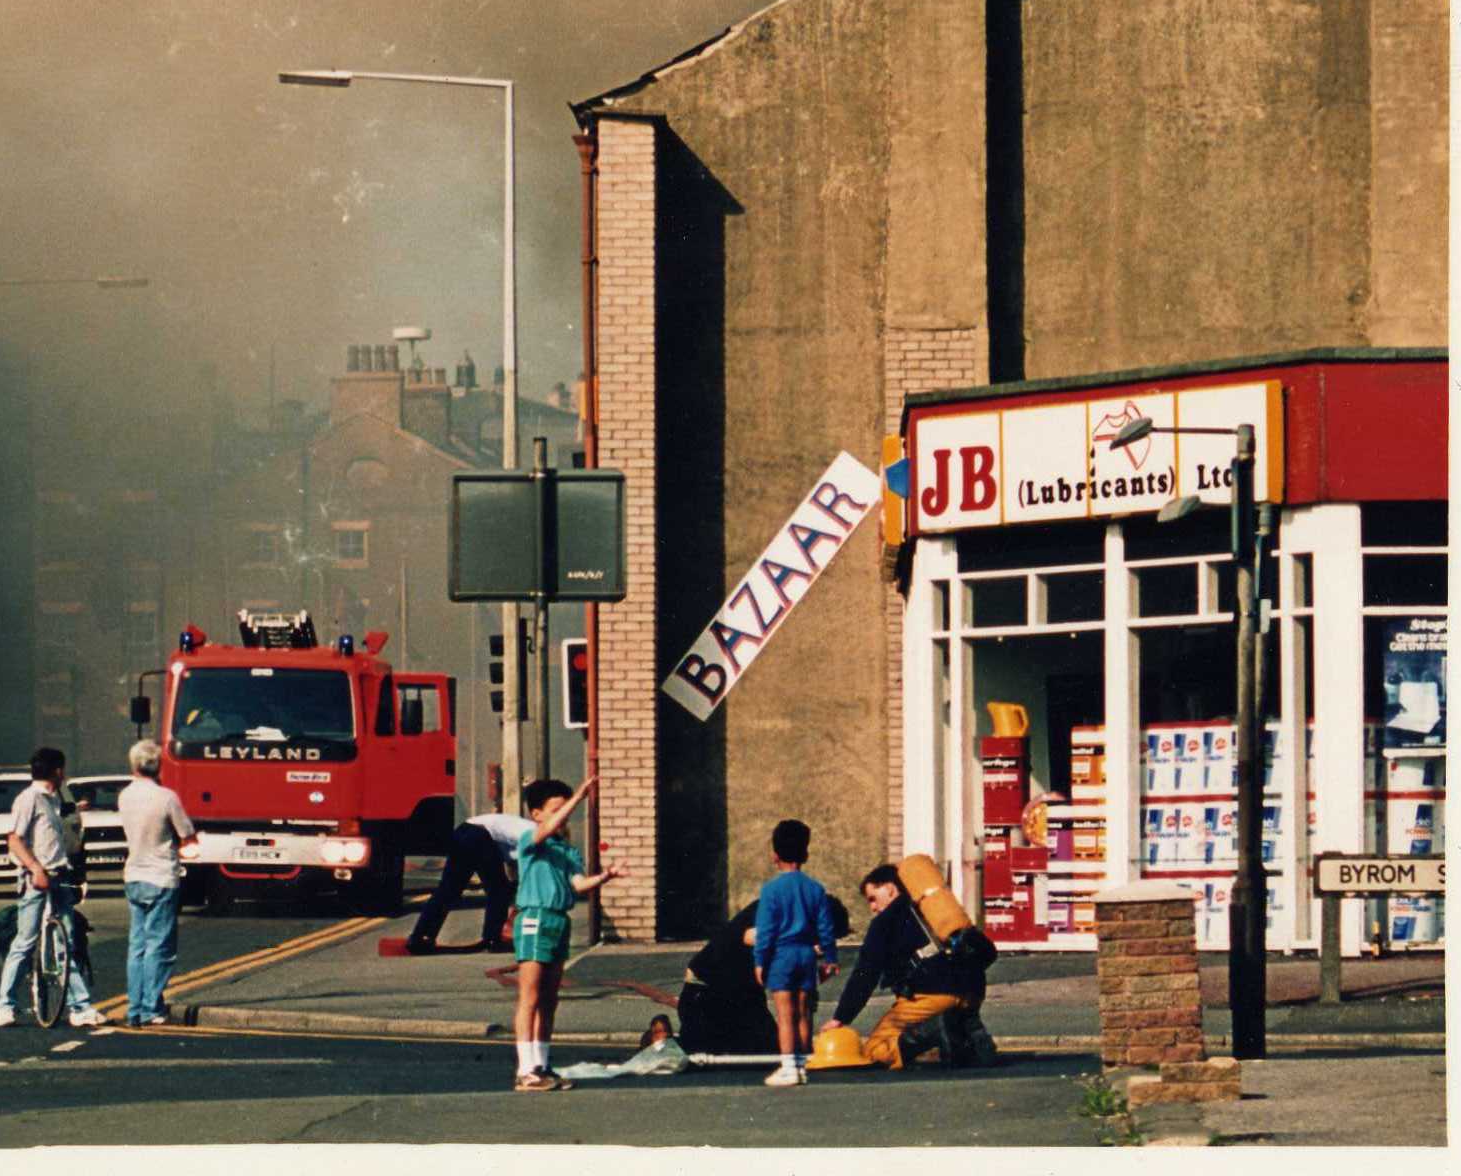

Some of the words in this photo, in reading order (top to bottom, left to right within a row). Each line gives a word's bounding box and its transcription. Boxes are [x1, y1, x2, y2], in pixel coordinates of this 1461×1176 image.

[920, 445, 998, 517] JB
[1017, 465, 1175, 508] (Lubricants)
[675, 480, 869, 707] BAZAAR
[203, 745, 321, 761] LEYLAND
[1339, 864, 1416, 884] BYROM
